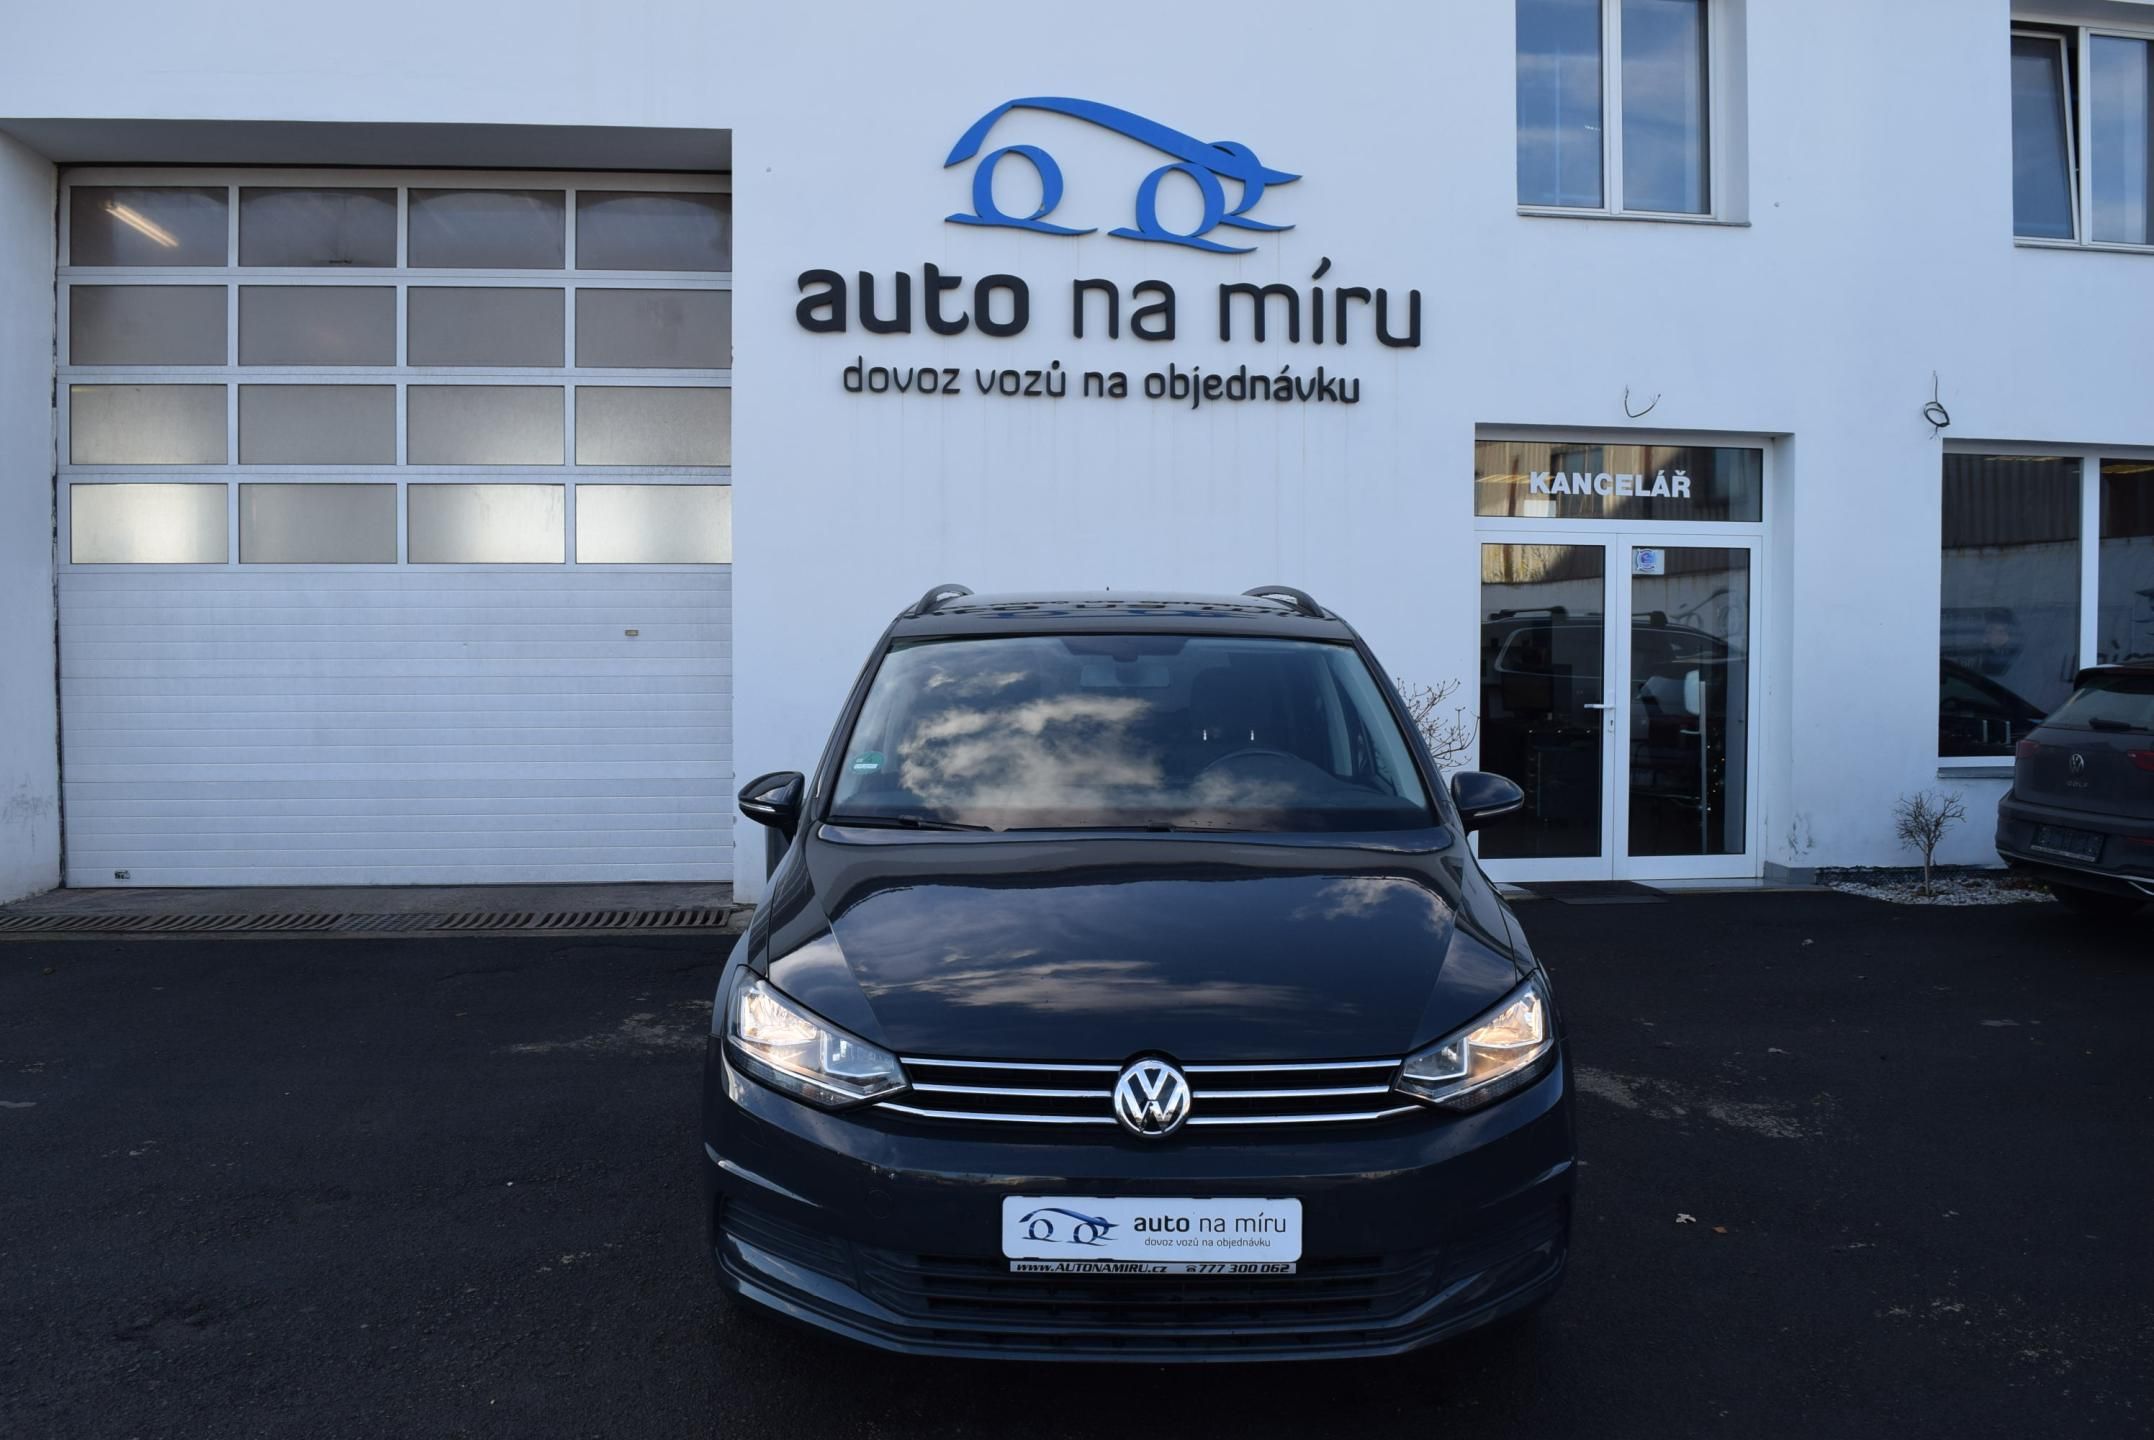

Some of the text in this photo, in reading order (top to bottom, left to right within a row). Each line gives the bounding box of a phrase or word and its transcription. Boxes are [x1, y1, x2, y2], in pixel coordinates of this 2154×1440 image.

[796, 257, 1422, 348] auto na míru
[843, 356, 1360, 409] dovoz vozů na objednávku
[1529, 470, 1691, 498] KANCELÁŘ
[1133, 1212, 1286, 1232] auto na míru
[1144, 1237, 1173, 1247] dovoz
[1202, 1239, 1214, 1247] na
[1216, 1237, 1271, 1249] objednávku
[1016, 1263, 1168, 1273] www.AUTONAMIRU.cz
[1200, 1264, 1290, 1273] 777 300 062
